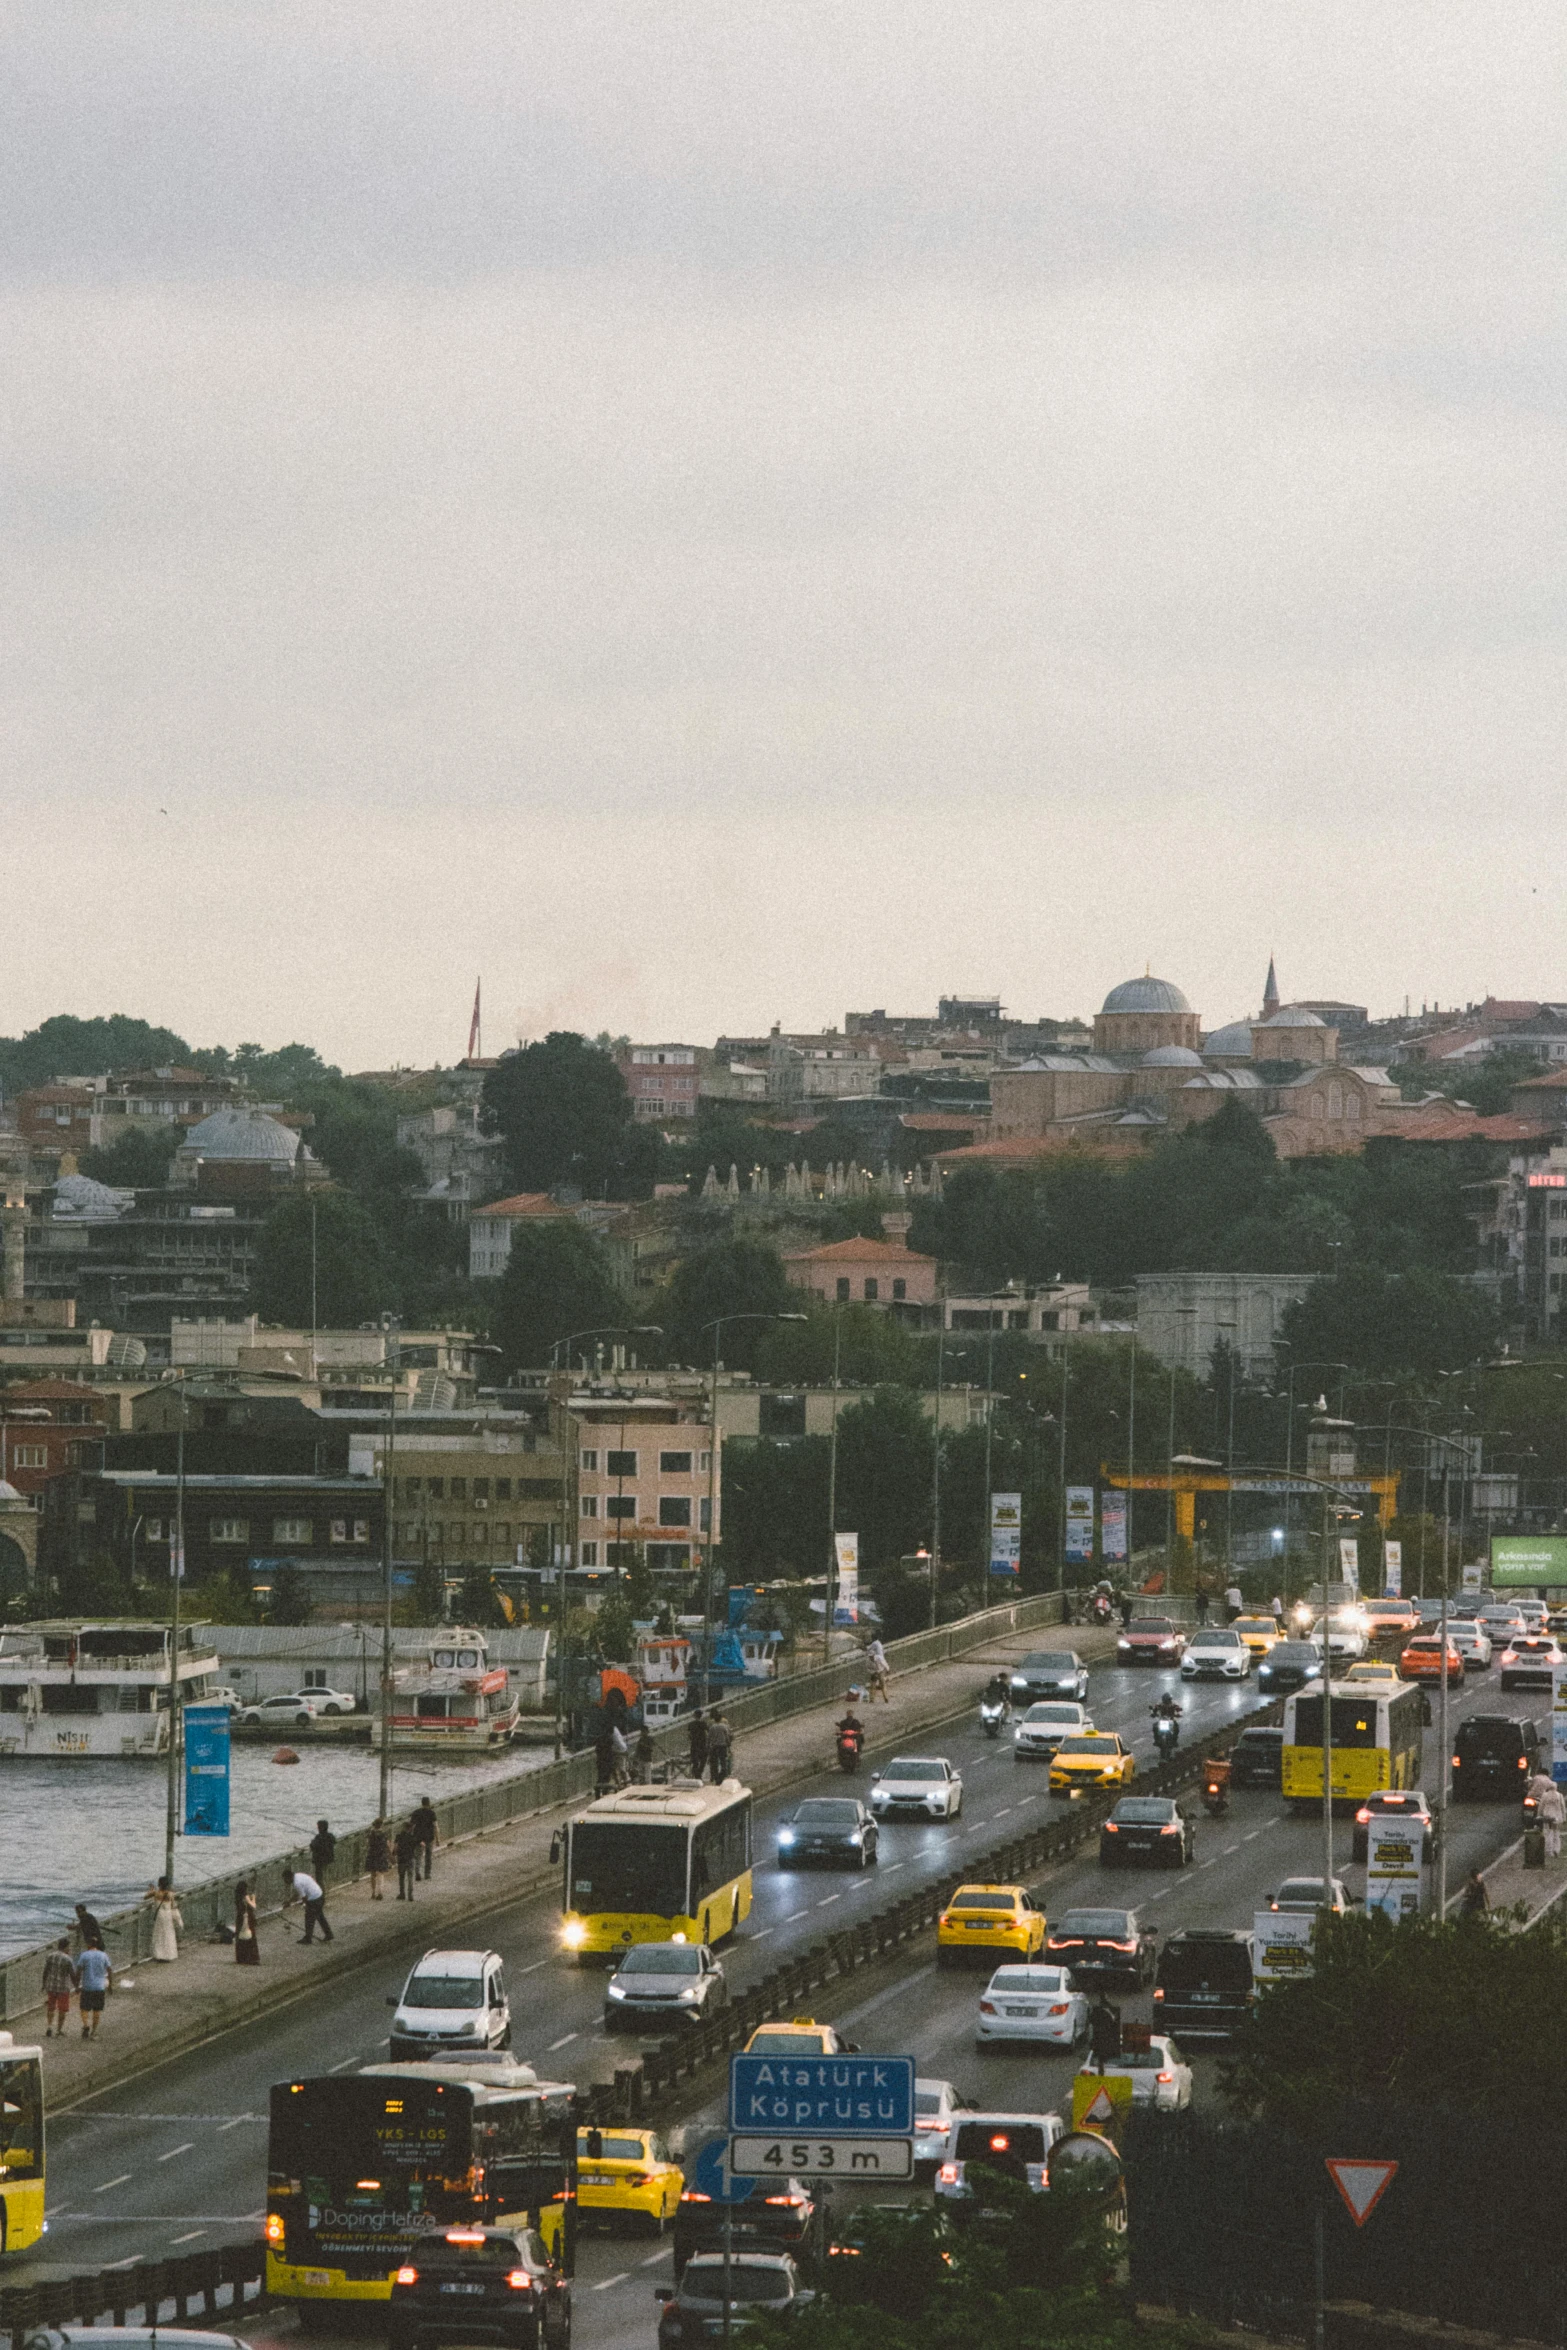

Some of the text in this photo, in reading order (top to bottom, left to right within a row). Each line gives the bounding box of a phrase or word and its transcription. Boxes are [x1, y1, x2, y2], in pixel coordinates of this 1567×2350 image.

[1498, 1551, 1553, 1561] Arkasında
[755, 2063, 888, 2087] Atatürk
[750, 2094, 894, 2123] Köprüsü
[376, 2128, 404, 2140] YKS
[420, 2128, 447, 2140] LGS
[763, 2144, 880, 2169] 453 m
